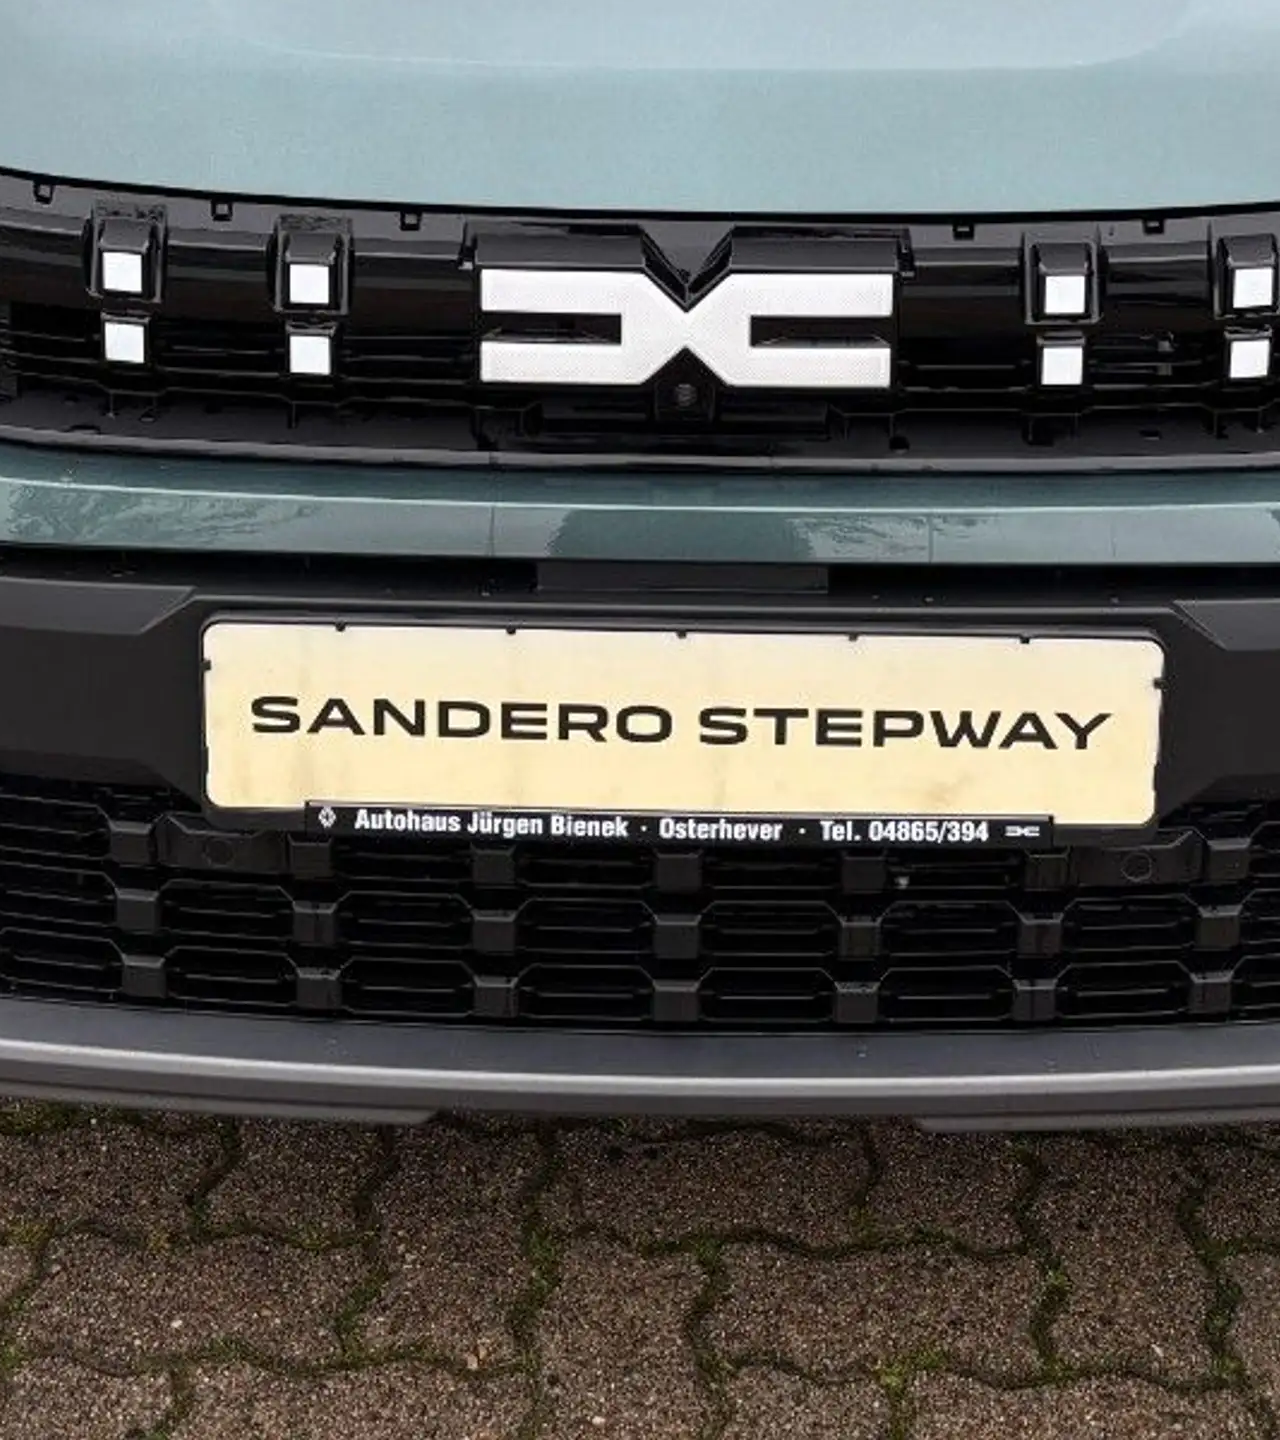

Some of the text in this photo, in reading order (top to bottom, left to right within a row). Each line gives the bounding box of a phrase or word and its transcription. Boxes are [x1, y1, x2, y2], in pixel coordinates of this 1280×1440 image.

[252, 697, 1110, 749] SANDERO STEPWAY
[355, 808, 989, 843] Autohaus Jürgen Bienek Osterhever Tel. 04865/394
